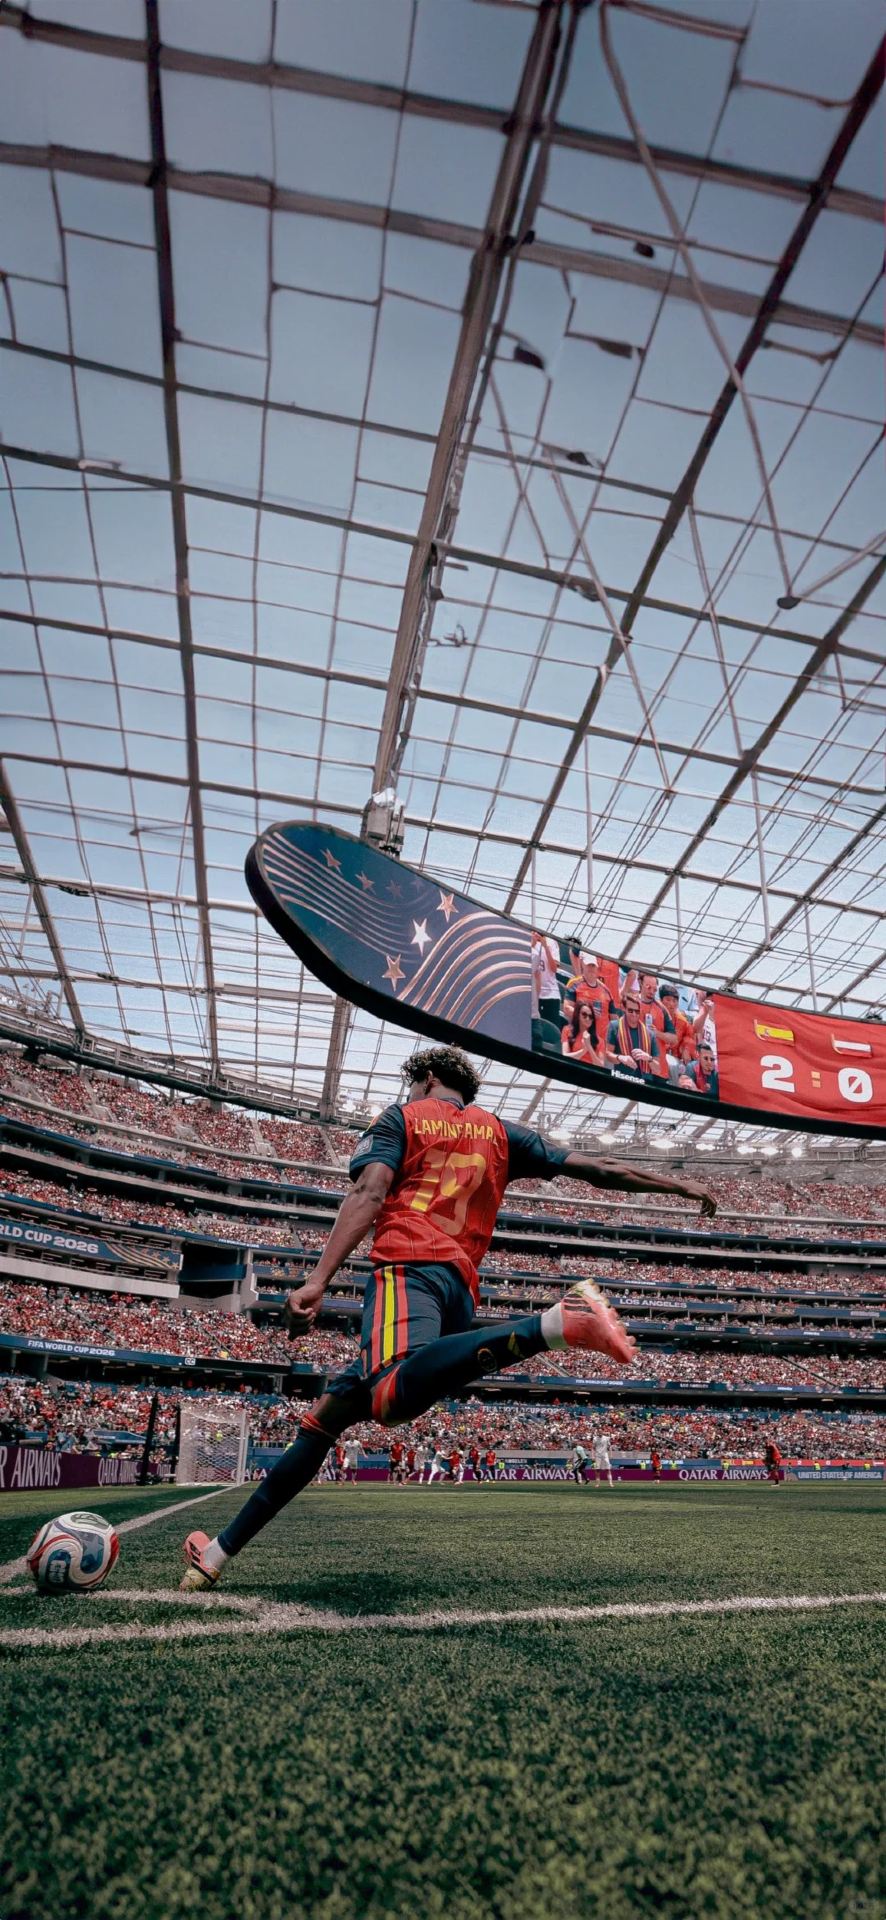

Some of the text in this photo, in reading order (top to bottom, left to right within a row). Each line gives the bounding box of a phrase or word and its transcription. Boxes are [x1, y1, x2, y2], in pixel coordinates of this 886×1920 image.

[611, 1069, 646, 1086] Hisense
[759, 1055, 796, 1093] 2
[838, 1066, 873, 1103] 0
[410, 1149, 487, 1236] 19
[24, 1229, 53, 1244] CUP
[53, 1236, 99, 1254] 2026
[620, 1298, 688, 1309] LOS ANGELES
[27, 1339, 116, 1357] FIFA WORLD CUP 2026
[10, 1447, 62, 1488] AIRWAYS
[98, 1457, 119, 1487] QATAR
[521, 1469, 576, 1480] AIRWAYS
[678, 1470, 769, 1481] QATAR AIRWAYS
[798, 1471, 821, 1479] UNITED
[854, 1471, 882, 1479] AMERICA
